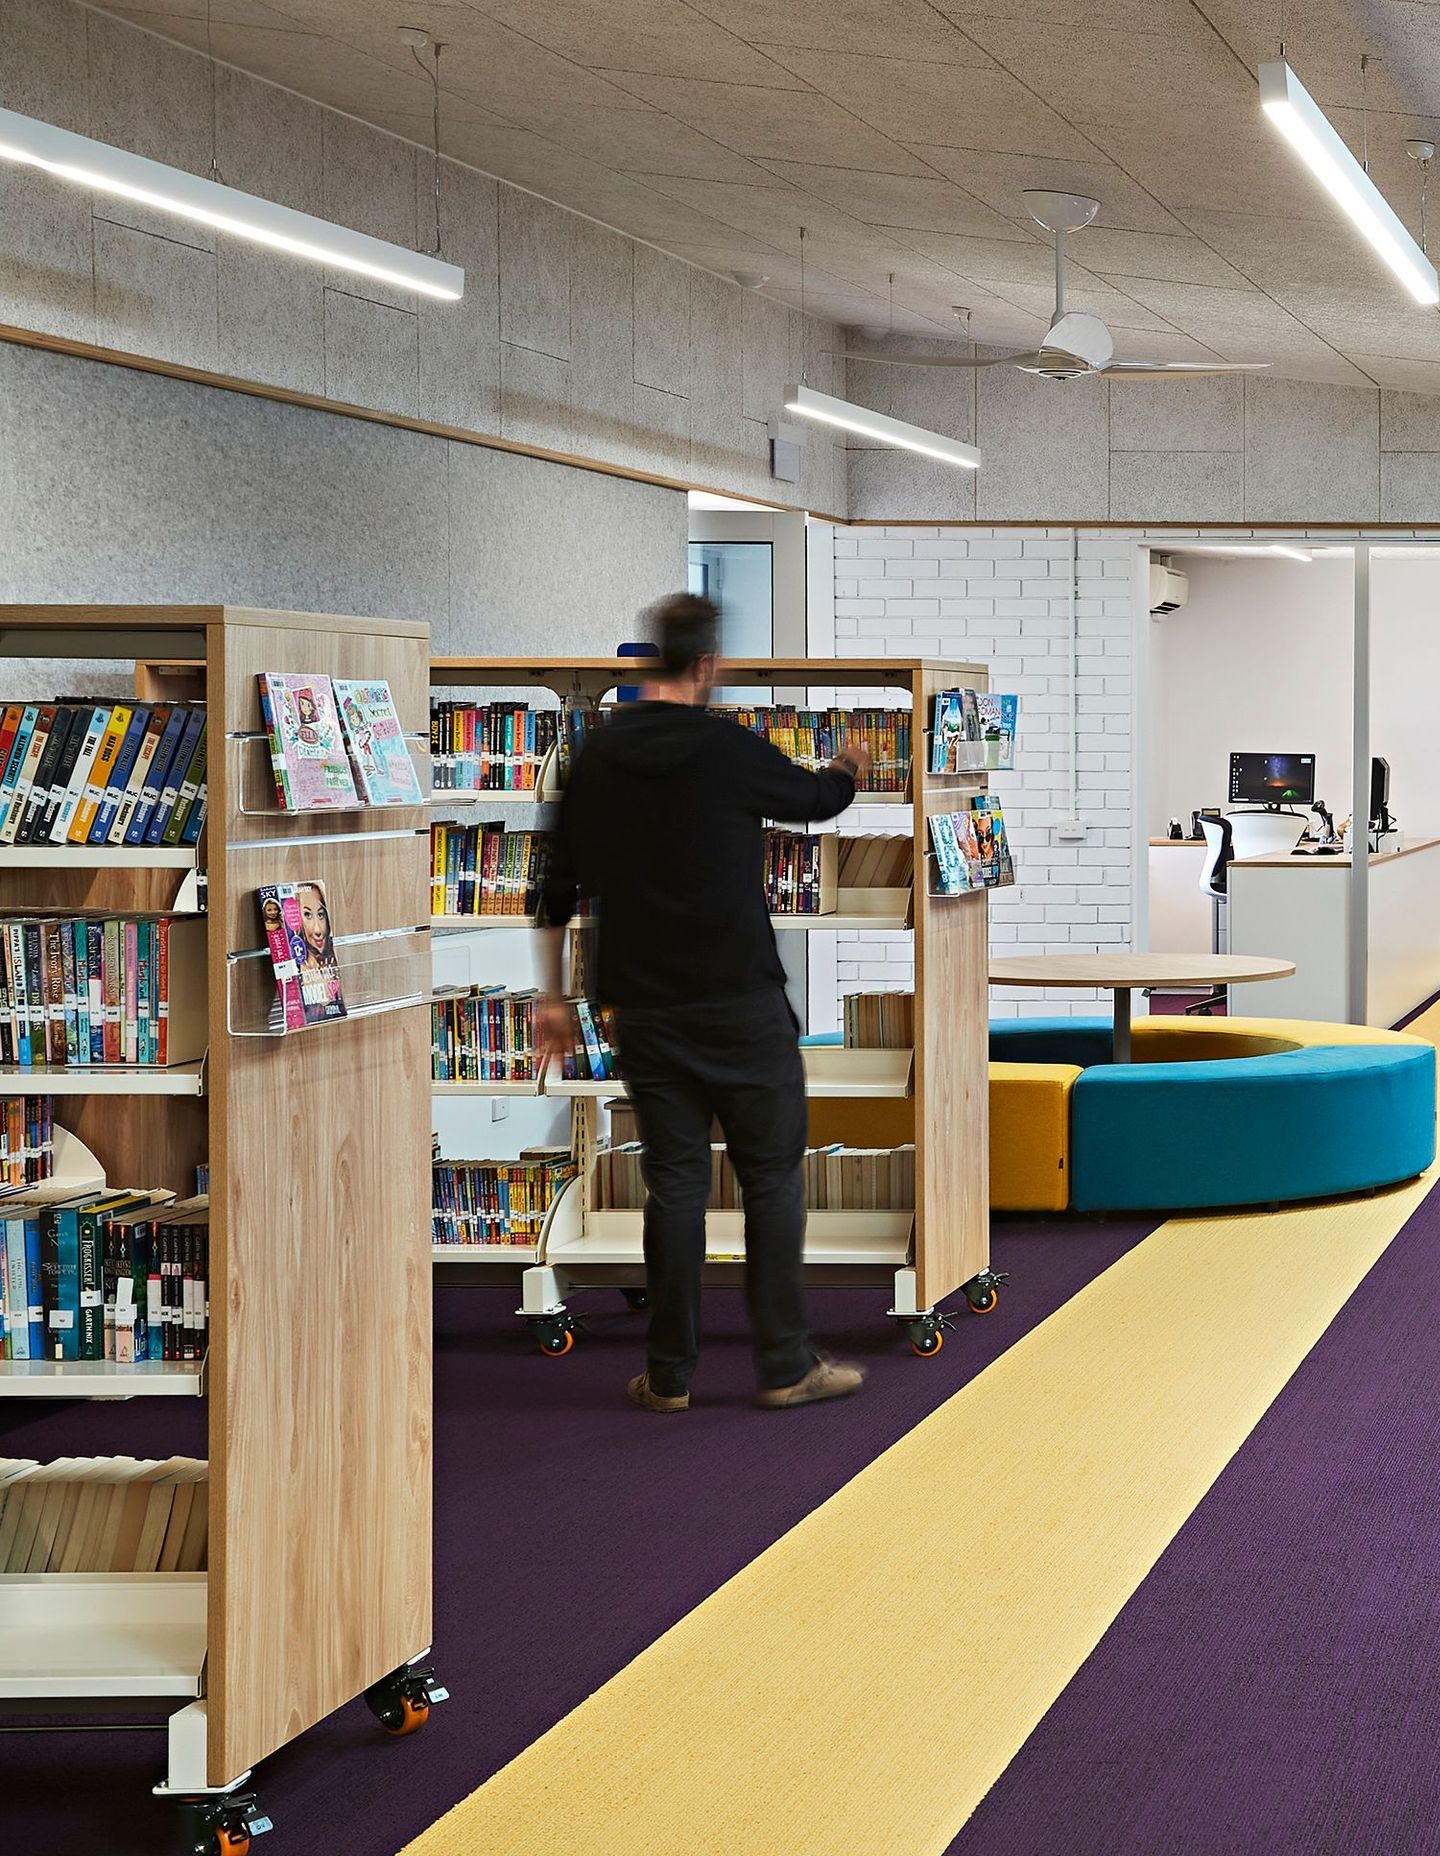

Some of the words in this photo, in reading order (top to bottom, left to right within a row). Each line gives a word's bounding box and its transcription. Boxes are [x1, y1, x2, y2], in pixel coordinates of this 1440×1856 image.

[260, 891, 276, 899] SKY
[49, 932, 60, 950] The
[14, 956, 23, 987] ISLAND
[50, 951, 61, 976] Ivory
[51, 977, 61, 999] Rose
[82, 1240, 94, 1285] FROGKISSER!
[85, 1309, 93, 1326] GARTH
[85, 1327, 93, 1344] NIX
